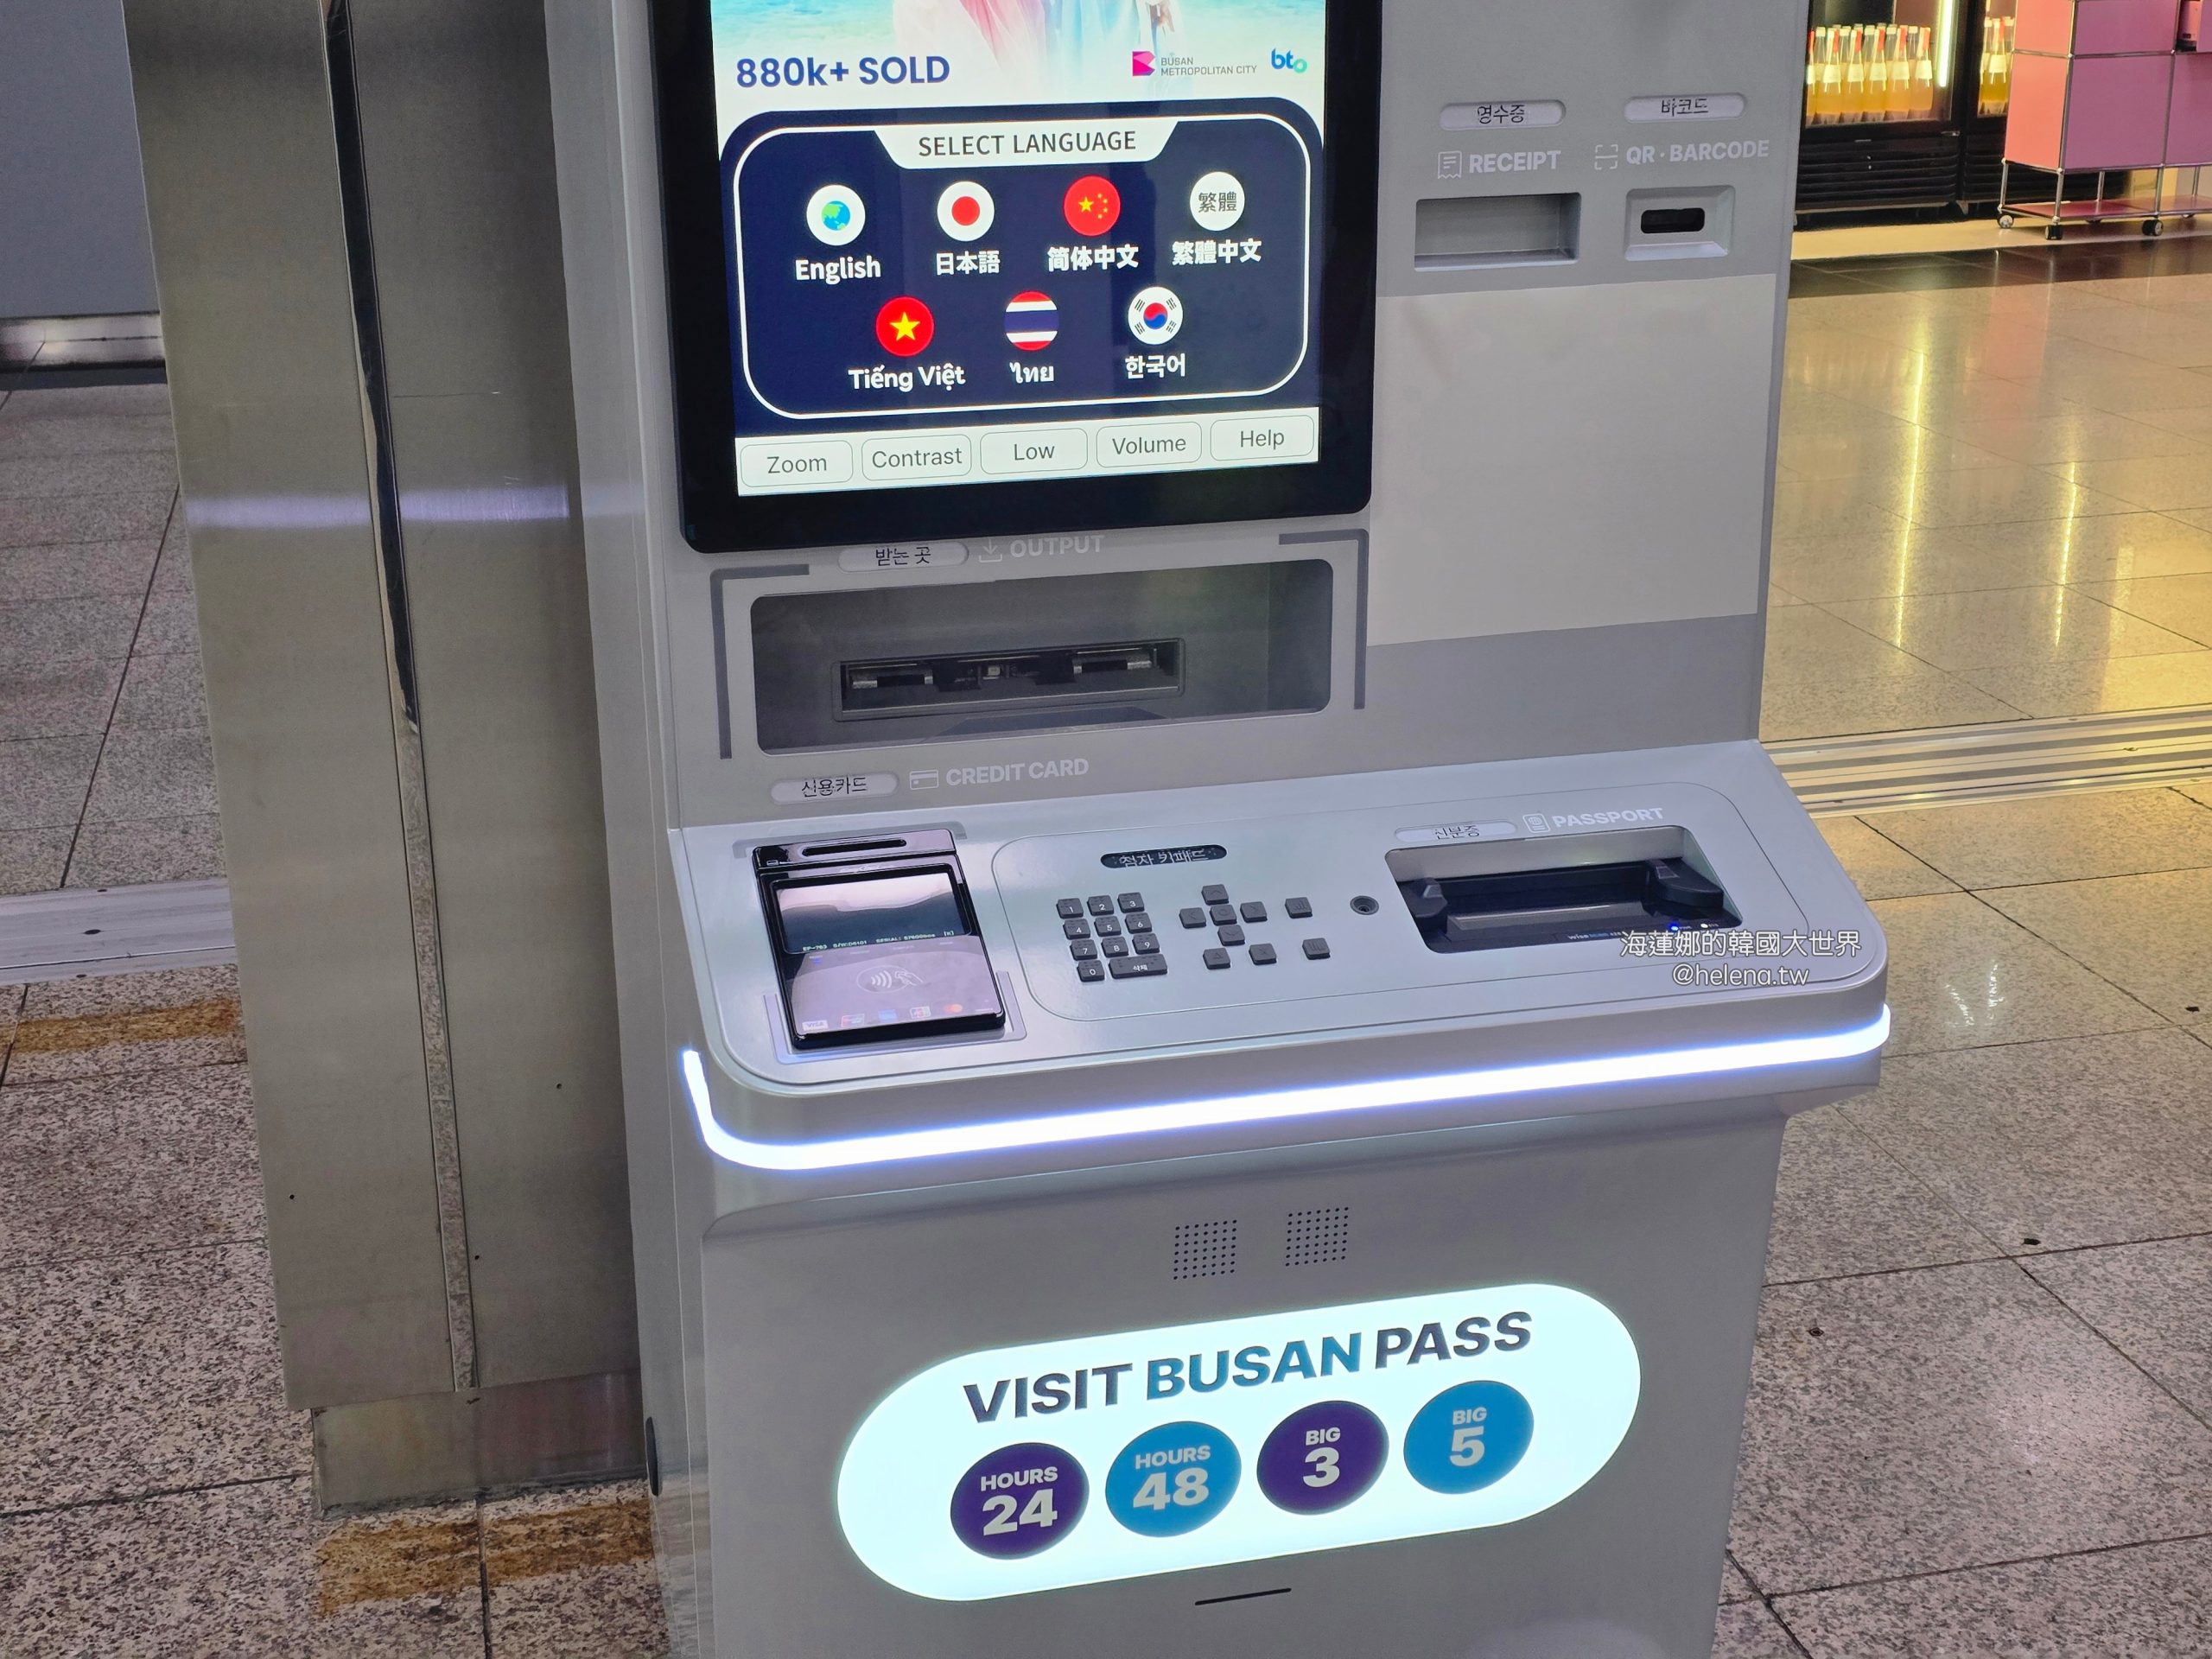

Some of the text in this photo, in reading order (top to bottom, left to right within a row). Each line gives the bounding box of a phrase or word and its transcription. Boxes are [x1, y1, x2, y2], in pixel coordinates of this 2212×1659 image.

[736, 56, 950, 87] 880k+ SOLD
[1160, 57, 1193, 67] BUSAN
[1160, 65, 1257, 76] METROPOLITAN CITY
[1271, 48, 1308, 73] bto
[1477, 104, 1525, 124] 영수증
[1660, 98, 1709, 117] 바코드
[918, 130, 1136, 157] SELECT LANGUAGE
[1626, 145, 1656, 164] QR
[1669, 139, 1770, 162] BARCODE
[1469, 149, 1561, 175] RECEIPT
[1198, 191, 1237, 213] 繁體
[936, 250, 1001, 276] 日本語
[1047, 244, 1139, 272] 简体中文
[1172, 238, 1262, 266] 繁體中文
[795, 255, 881, 285] English
[848, 362, 966, 392] Tiếng Việt
[1009, 361, 1055, 384] ไทย
[1125, 353, 1186, 380] 한국어
[1014, 442, 1056, 461] Low
[1112, 436, 1187, 455] Volume
[1240, 429, 1285, 450] Help
[767, 455, 827, 474] Zoom
[872, 447, 963, 469] Contrast
[875, 546, 931, 566] 받는 곳
[1009, 534, 1105, 559] OUTPUT
[945, 757, 1090, 786] CREDIT CARD
[801, 776, 868, 798] 신용카드
[1551, 807, 1664, 828] PASSPORT
[963, 1311, 1533, 1424] VISIT BUSAN PASS
[1452, 1406, 1488, 1426] BIG
[1305, 1427, 1341, 1446] BIG
[1449, 1426, 1485, 1467] 5
[1135, 1445, 1211, 1470] HOURS
[1302, 1446, 1341, 1488] 3
[980, 1466, 1058, 1492] HOURS
[1133, 1467, 1210, 1511] 48
[982, 1488, 1058, 1536] 24
